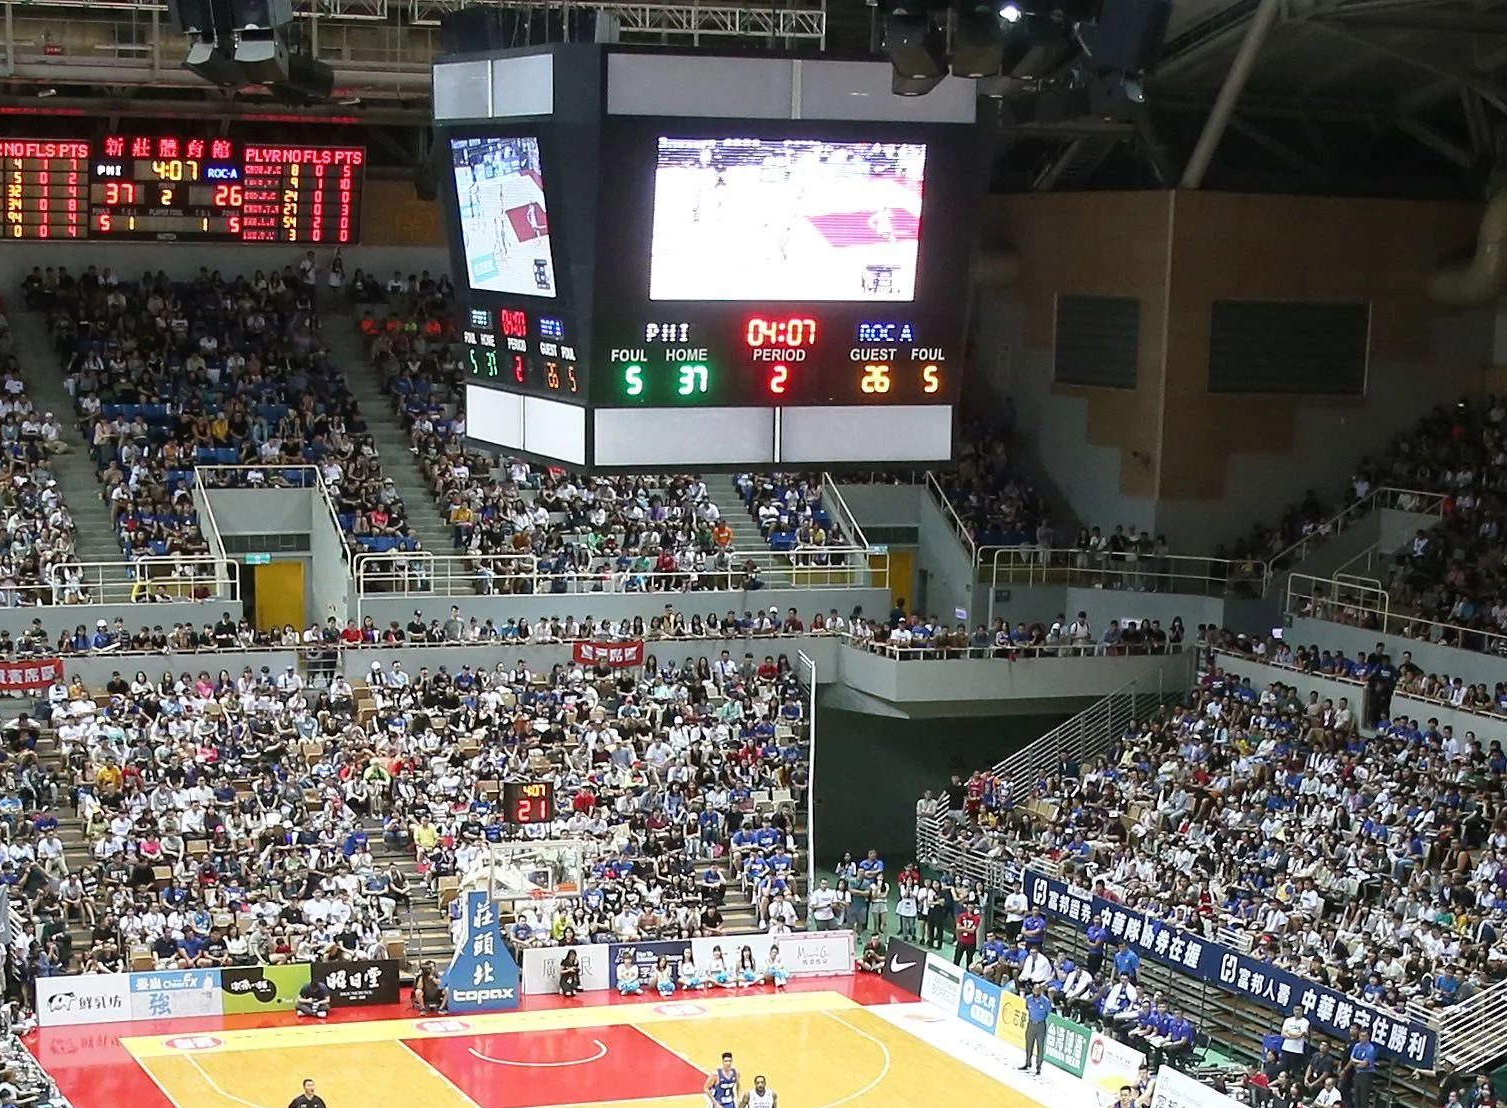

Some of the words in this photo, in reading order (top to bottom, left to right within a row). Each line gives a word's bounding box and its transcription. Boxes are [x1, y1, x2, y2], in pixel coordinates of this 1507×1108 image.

[4, 143, 24, 156] NO
[26, 144, 56, 157] FLS
[59, 144, 89, 158] PTS
[246, 149, 282, 162] PLYR
[283, 150, 302, 162] NO
[303, 150, 331, 164] FLS
[334, 152, 362, 164] PTS
[14, 158, 23, 170] 4
[70, 158, 77, 171] 7
[96, 165, 122, 176] PHI
[152, 160, 198, 181] 4:07
[290, 164, 300, 176] 8
[315, 164, 324, 176] 0
[343, 165, 351, 177] 5
[14, 172, 23, 184] 5
[39, 172, 48, 184] 0
[68, 172, 77, 185] 2
[207, 168, 238, 178] ROC-A
[8, 184, 23, 198] 32
[68, 186, 77, 198] 4
[290, 177, 299, 189] 9
[340, 178, 350, 190] 10
[106, 183, 134, 204] 37
[161, 189, 173, 206] 2
[215, 186, 243, 206] 26
[283, 190, 299, 202] 24
[314, 190, 322, 202] 0
[342, 192, 350, 203] 0
[8, 198, 23, 211] 34
[39, 198, 48, 211] 0
[68, 198, 77, 211] 8
[283, 203, 298, 215] 27
[313, 204, 322, 216] 0
[341, 204, 349, 216] 3
[7, 212, 23, 224] 94
[68, 212, 77, 224] 4
[99, 214, 111, 231] 5
[129, 216, 135, 230] 1
[202, 217, 209, 232] 1
[230, 217, 240, 233] 5
[282, 216, 298, 228] 54
[312, 216, 322, 228] 2
[340, 218, 349, 229] 0
[13, 224, 23, 238] 0
[39, 224, 48, 238] 0
[68, 225, 77, 238] 4
[288, 229, 297, 242] 3
[312, 229, 321, 242] 0
[340, 230, 348, 242] 0
[645, 324, 690, 344] PHI
[746, 318, 817, 346] 04:07
[507, 337, 527, 353] PERIOD
[540, 342, 559, 358] GUEST
[560, 346, 577, 361] FOUL
[611, 350, 648, 362] FOUL
[665, 349, 708, 362] HOME
[752, 349, 807, 362] PERIOD
[850, 348, 898, 361] GUEST
[911, 348, 946, 361] FOUL
[624, 366, 644, 396] 5
[678, 366, 709, 394] 37
[769, 366, 787, 394] 2
[861, 365, 890, 393] 26
[923, 365, 939, 393] 5
[518, 800, 546, 821] 21
[1236, 966, 1292, 1007] 富邦人壽
[452, 988, 514, 1005] topax
